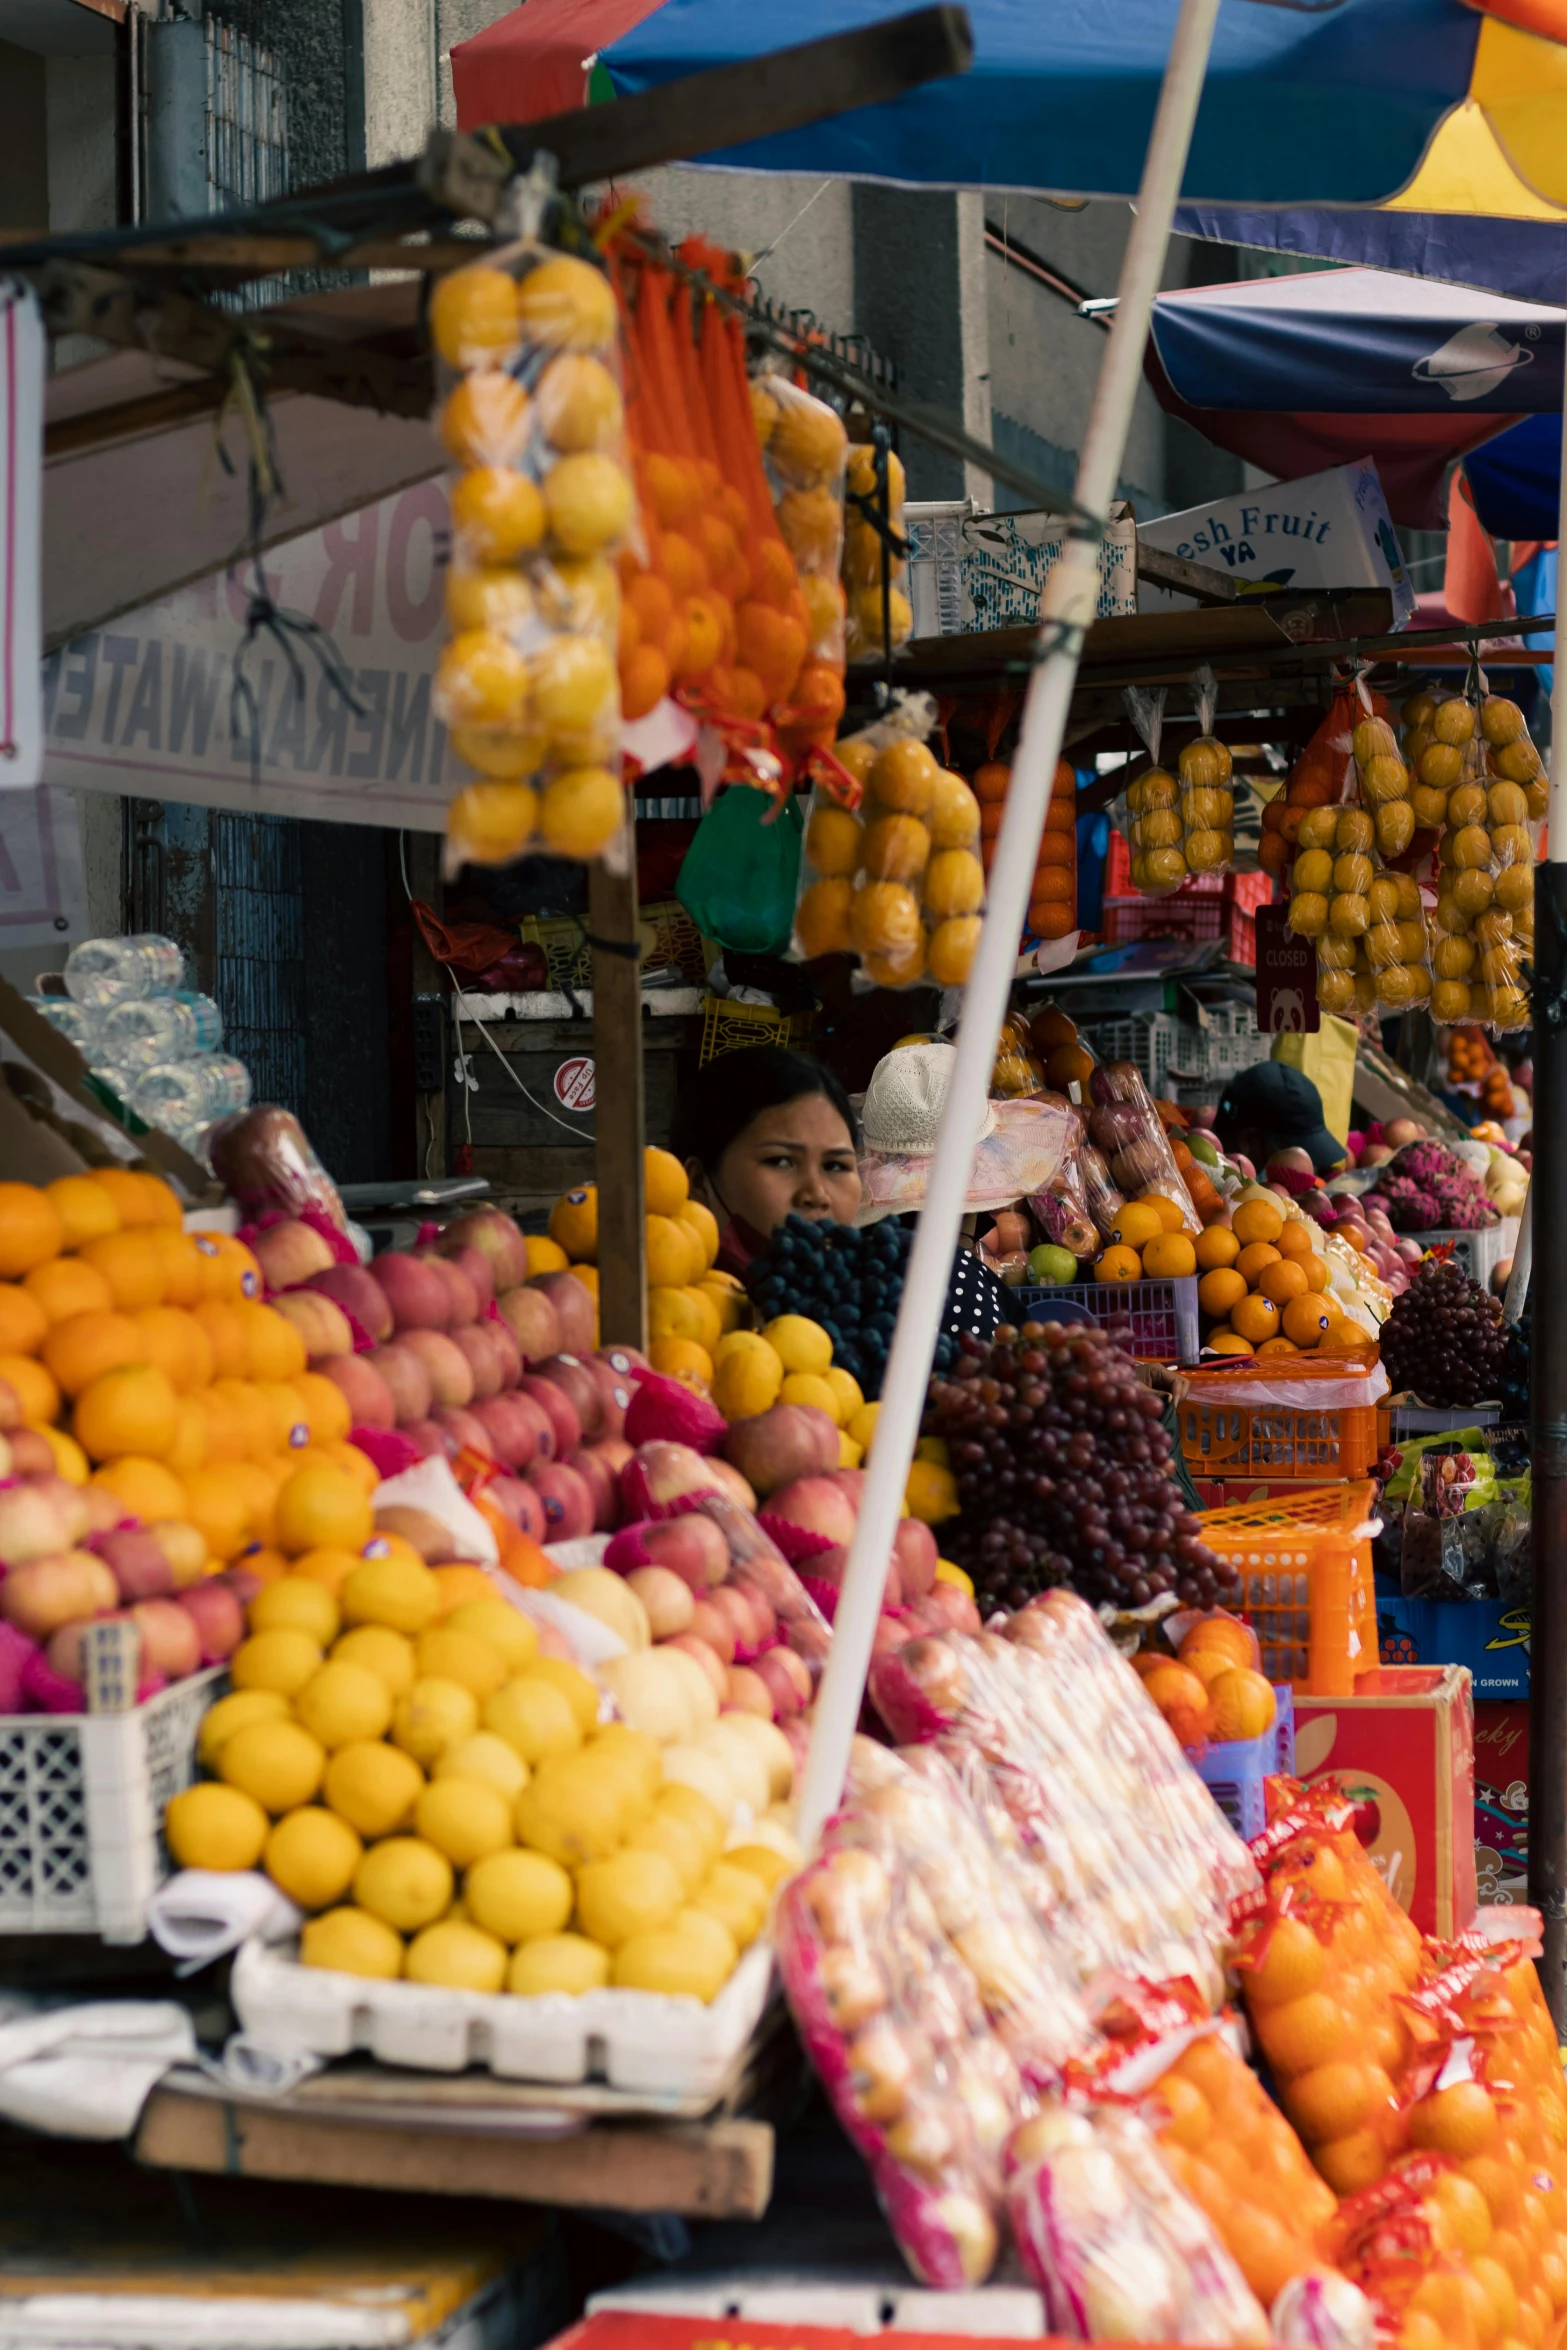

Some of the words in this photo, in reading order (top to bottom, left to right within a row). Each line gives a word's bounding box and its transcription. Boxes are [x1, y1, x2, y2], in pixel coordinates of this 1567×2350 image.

[1177, 517, 1232, 560] esh
[1239, 506, 1332, 544] Fruit
[1220, 541, 1256, 567] YA
[1266, 950, 1308, 967] CLOSED
[581, 1068, 593, 1080] Up
[569, 1082, 584, 1100] Face
[1480, 1679, 1519, 1687] GROWN
[1473, 1716, 1523, 1757] cky
